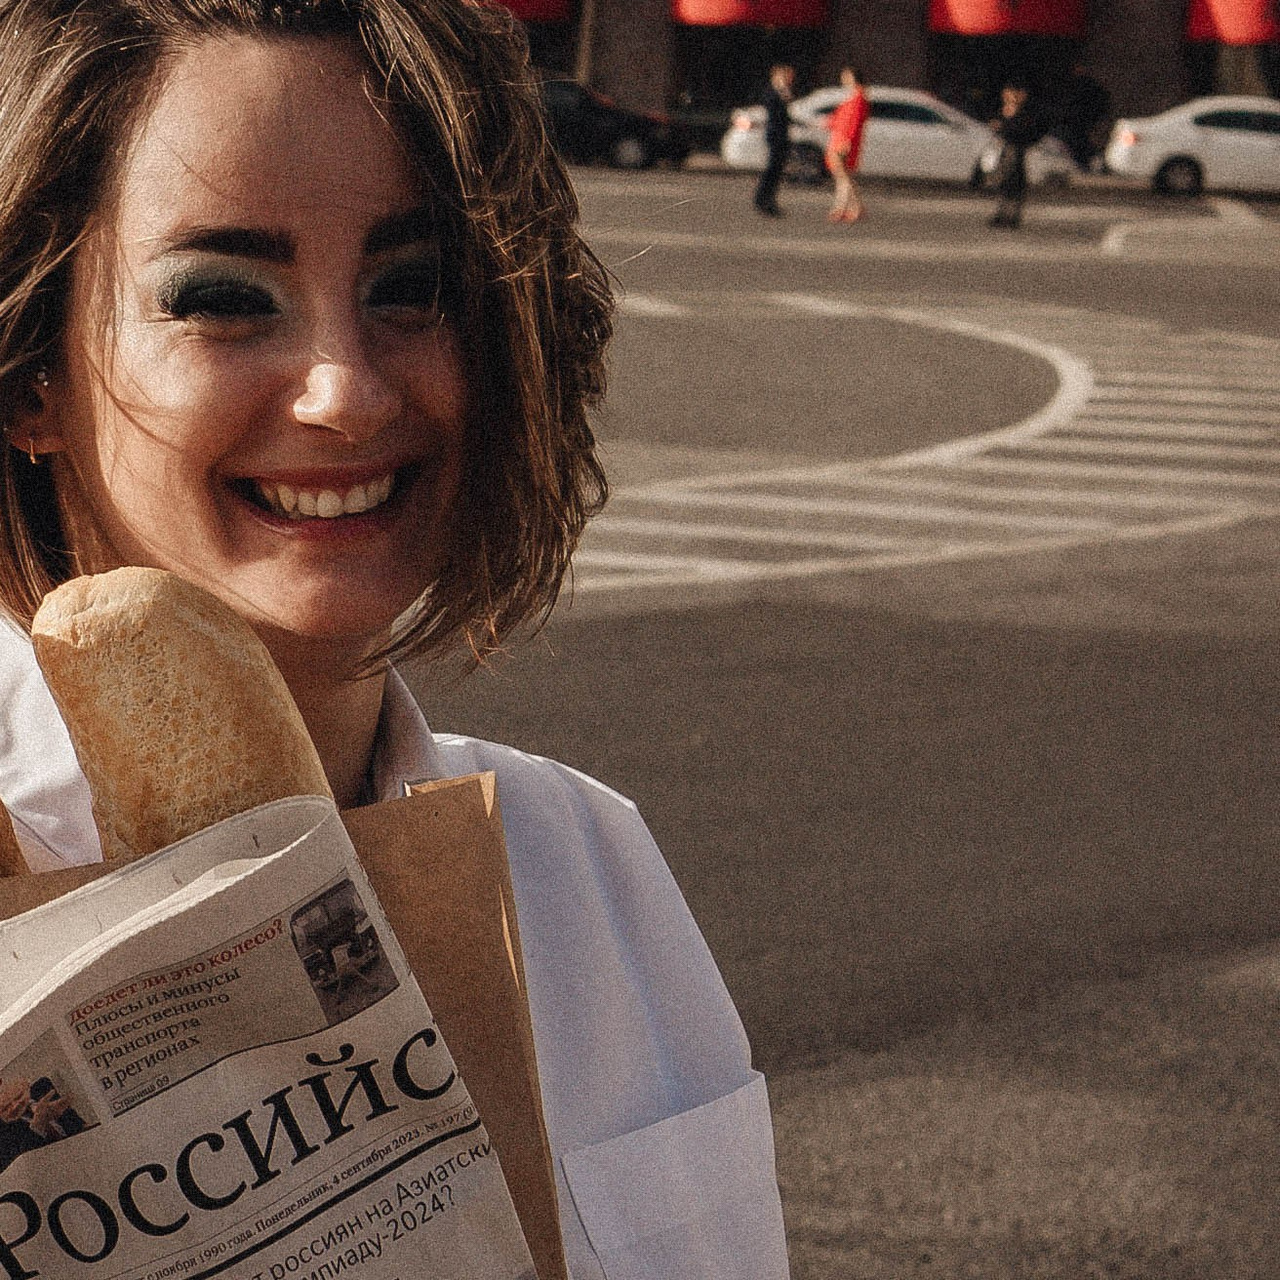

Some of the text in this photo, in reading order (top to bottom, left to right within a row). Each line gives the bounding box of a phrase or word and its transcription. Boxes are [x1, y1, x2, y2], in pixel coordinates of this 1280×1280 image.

[70, 919, 283, 1026] Доедет ли это колесо?
[75, 968, 241, 1037] Плюсы и минусы
[82, 992, 230, 1051] общественного
[90, 1017, 202, 1070] транспорта
[102, 1036, 202, 1091] в регионах
[154, 1256, 198, 1280] ноября
[200, 1241, 226, 1264] 1990
[333, 1175, 341, 1186] 4
[340, 1146, 393, 1180] сентября
[440, 1113, 461, 1130] 197
[365, 1200, 395, 1224] на
